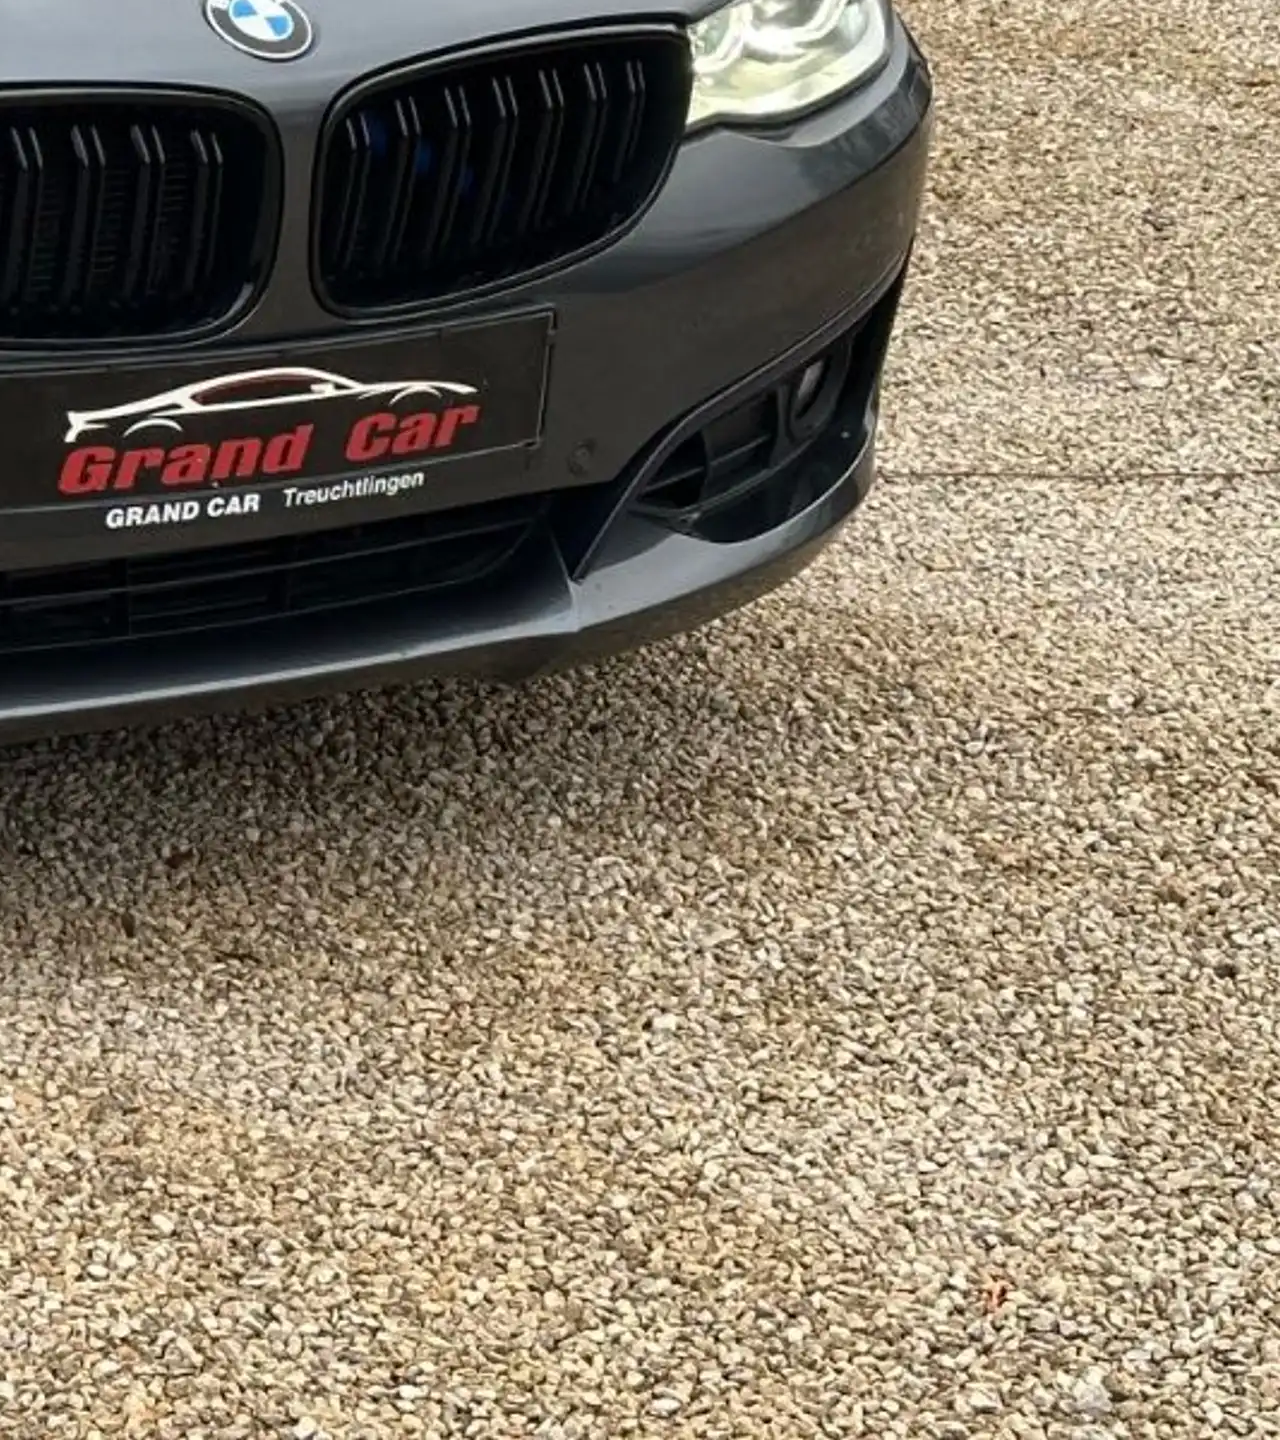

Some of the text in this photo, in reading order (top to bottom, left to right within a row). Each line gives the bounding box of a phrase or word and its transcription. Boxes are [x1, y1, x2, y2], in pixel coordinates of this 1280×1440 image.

[58, 405, 481, 494] Grand Car
[106, 470, 426, 529] GRAND CAR Treuchtlingen
